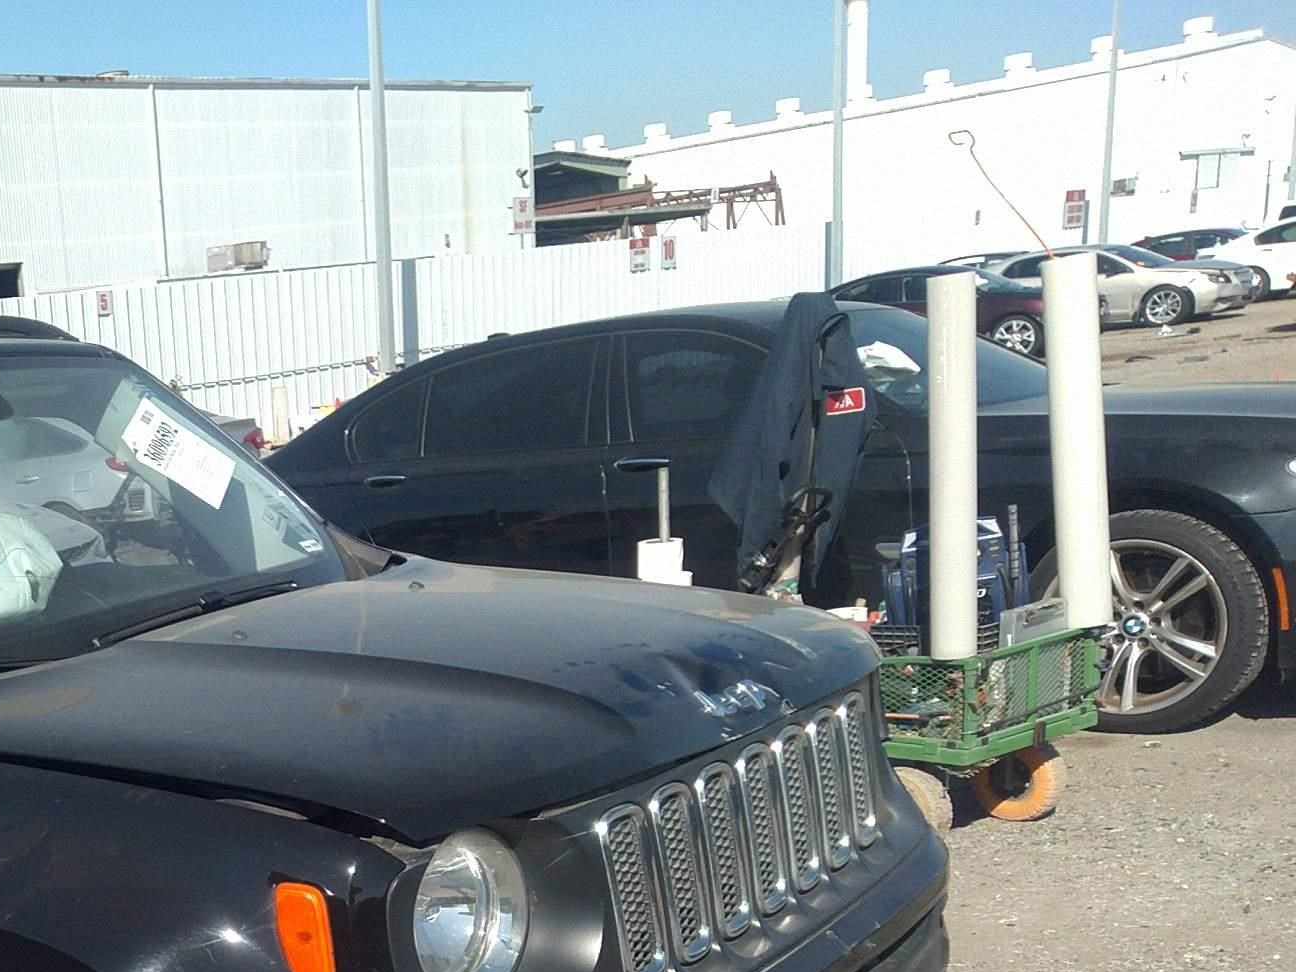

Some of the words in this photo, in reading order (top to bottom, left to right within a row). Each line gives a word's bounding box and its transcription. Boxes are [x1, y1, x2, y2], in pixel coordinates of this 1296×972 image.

[663, 239, 675, 260] 10
[100, 294, 108, 311] 5
[144, 421, 179, 467] 36096592
